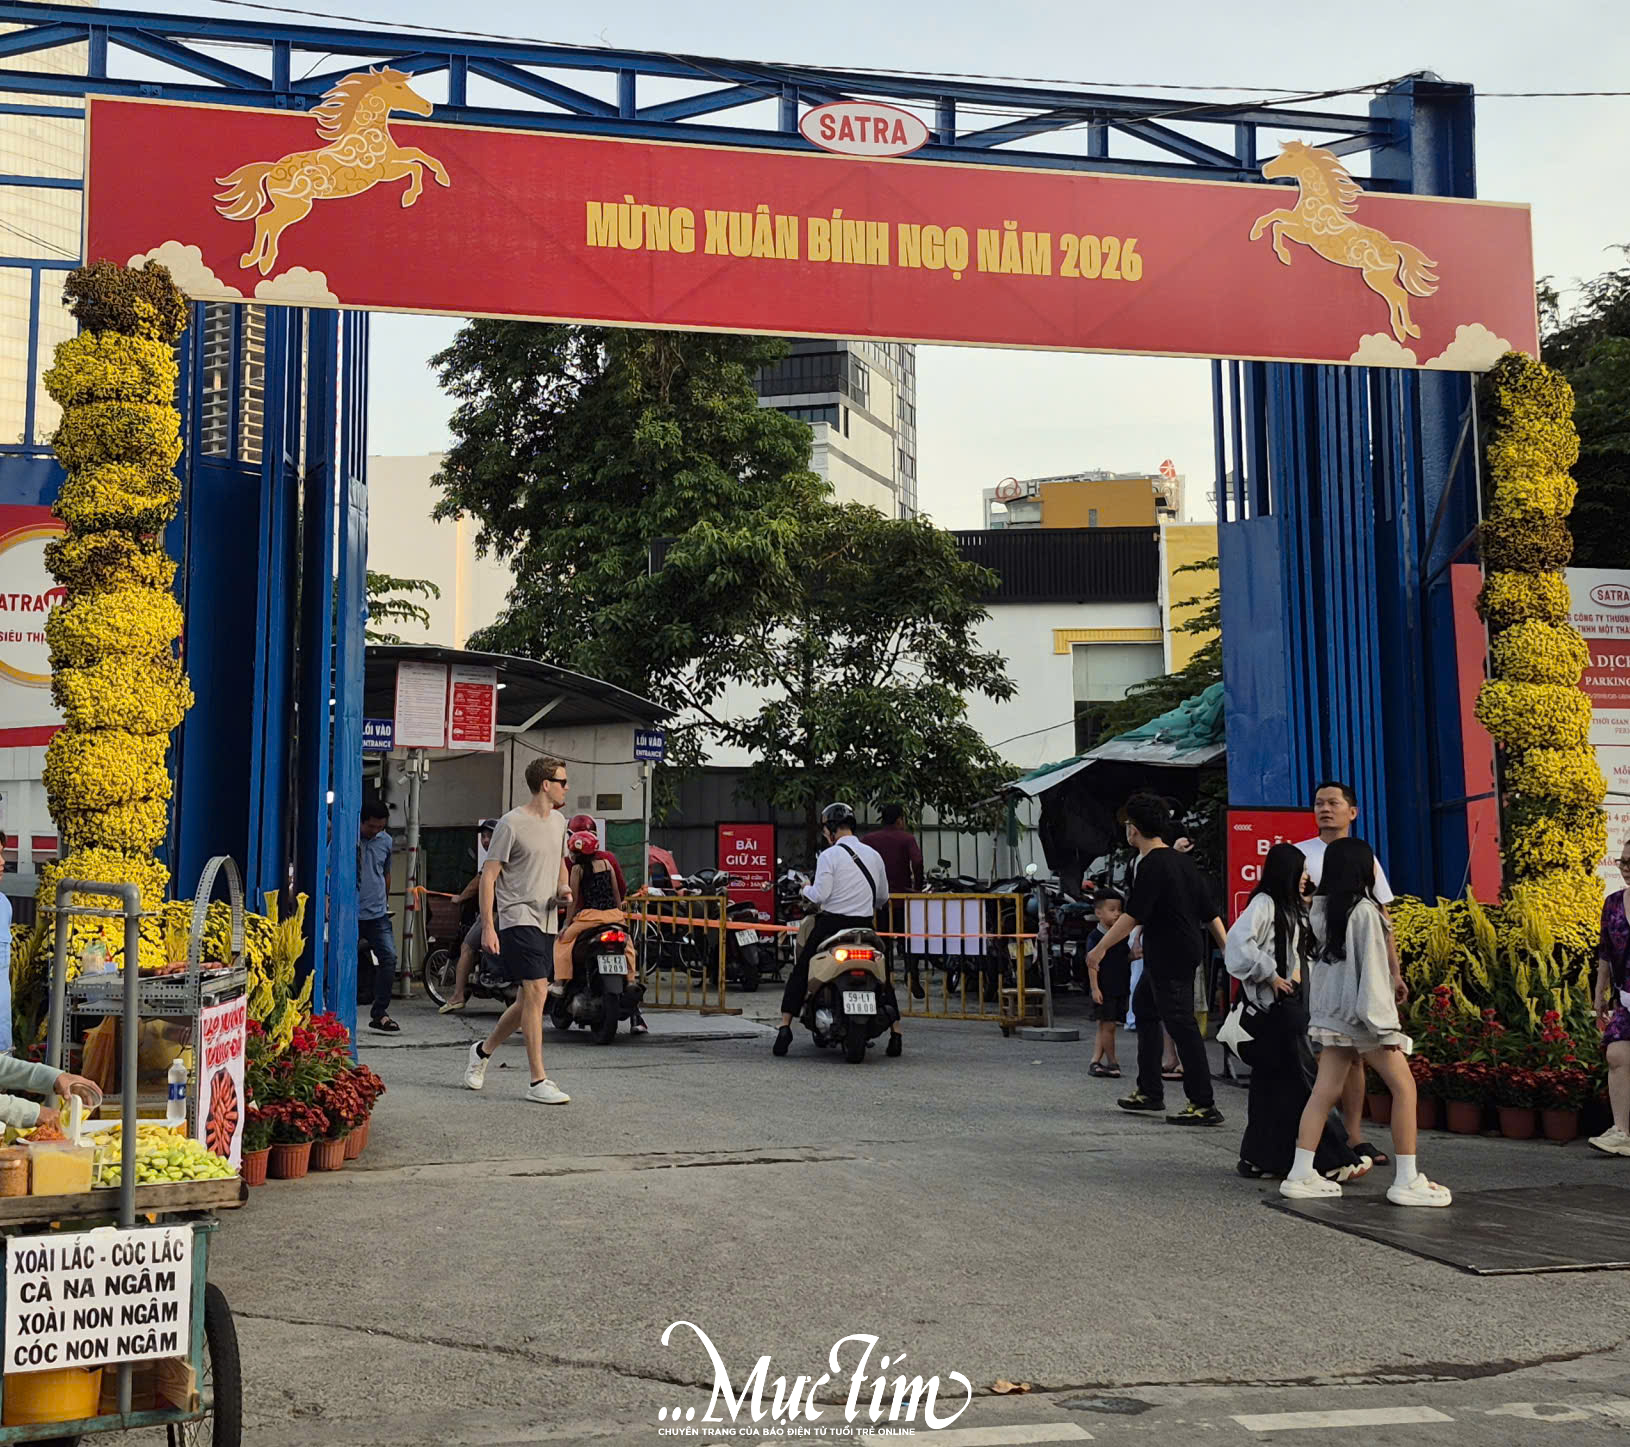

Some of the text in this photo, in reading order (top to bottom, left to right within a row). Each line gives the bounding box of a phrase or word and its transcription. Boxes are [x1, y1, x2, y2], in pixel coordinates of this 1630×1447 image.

[819, 113, 908, 146] SATRA
[586, 194, 1142, 282] MỪNG XUÂN BÍNH NGỌ NĂM 2026
[1597, 589, 1630, 601] SATRA
[362, 721, 373, 735] ỐI
[362, 739, 392, 748] NTRANCE
[736, 838, 757, 850] BÃI
[726, 853, 768, 865] GIỮ XE
[1241, 864, 1263, 881] GI
[14, 1243, 55, 1274] XOÀI
[61, 1236, 95, 1271] LẮC
[112, 1236, 146, 1267] CÓC
[152, 1230, 184, 1264] LẮC
[20, 1268, 175, 1303] CÀ NA NGÂM
[17, 1297, 178, 1336] XOÀI NON NGÂM
[14, 1328, 177, 1366] CÓC NON NGÂM
